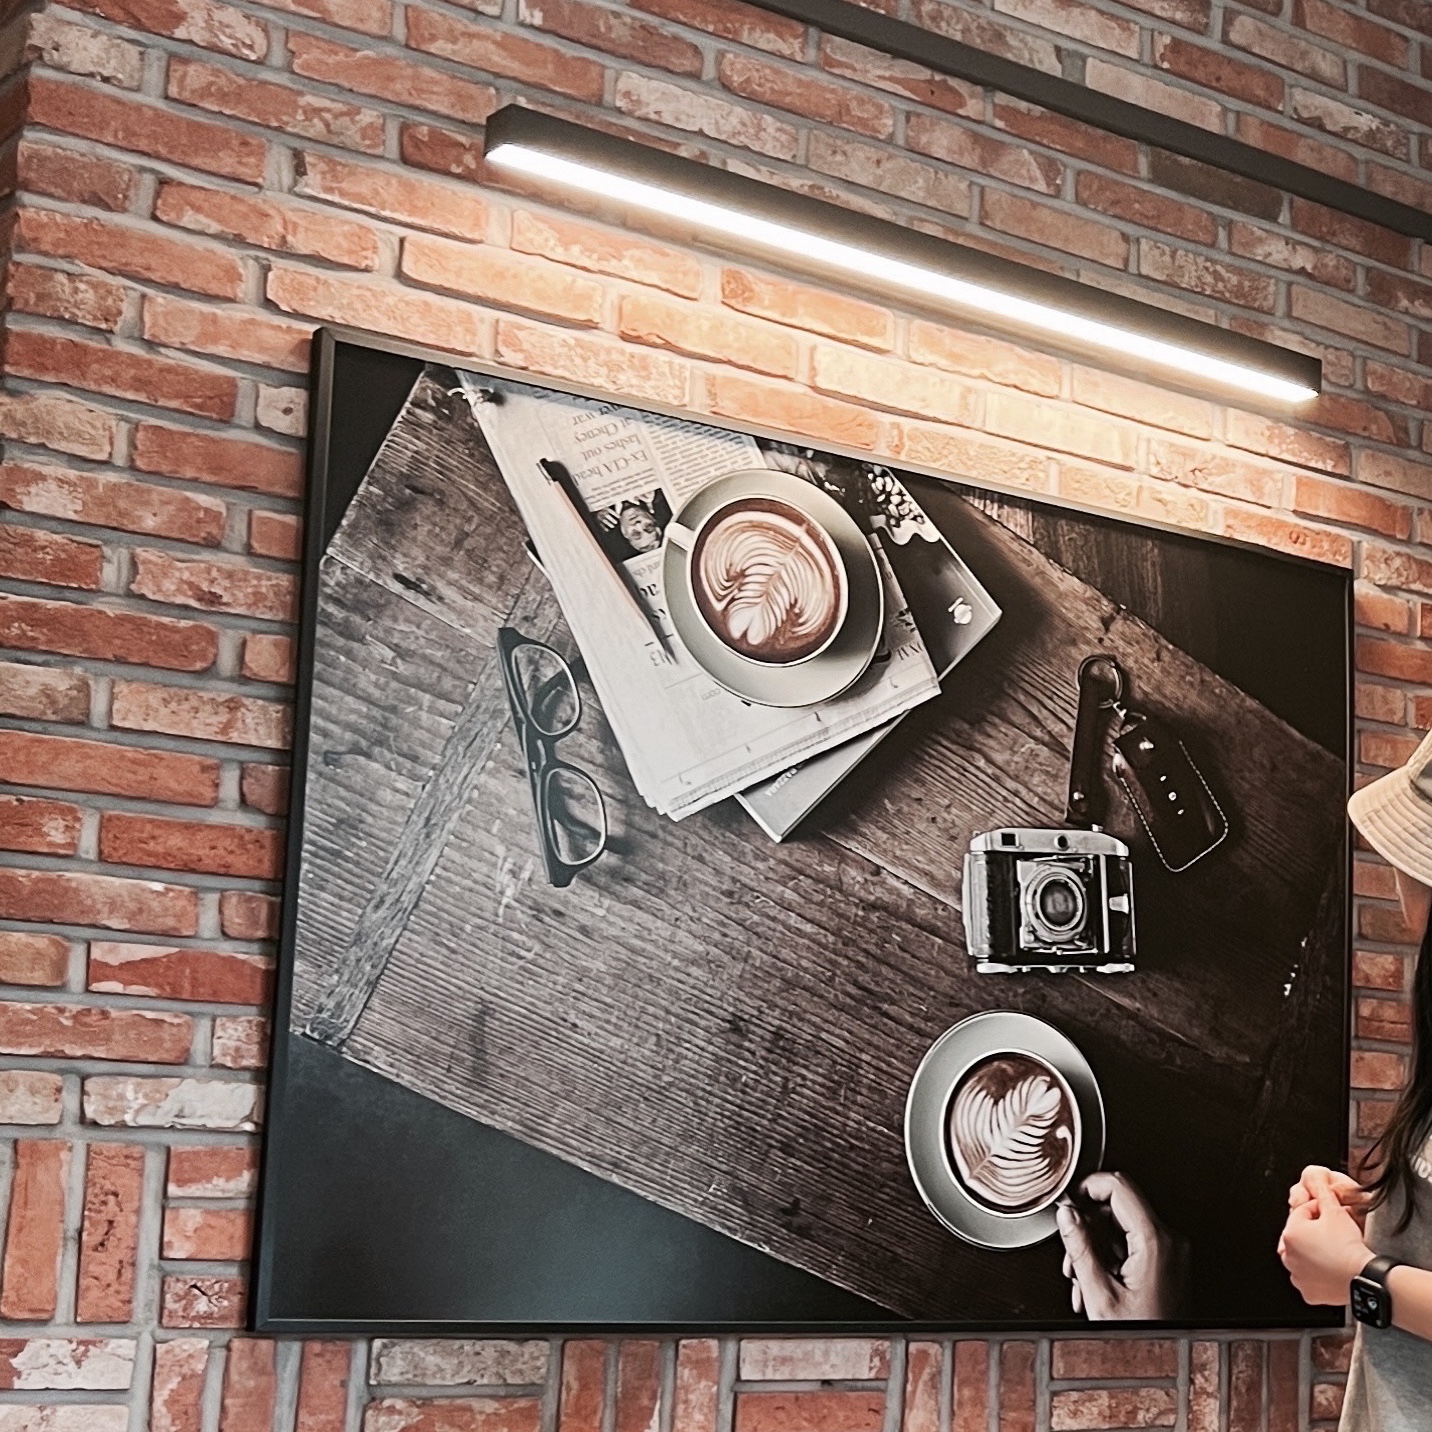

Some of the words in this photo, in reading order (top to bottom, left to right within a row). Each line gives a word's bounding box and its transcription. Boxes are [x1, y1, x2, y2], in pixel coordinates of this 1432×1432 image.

[575, 422, 618, 443] Cheney
[604, 434, 641, 450] lashes
[581, 446, 602, 460] out
[603, 450, 648, 473] Ex-CIA
[572, 467, 604, 487] head
